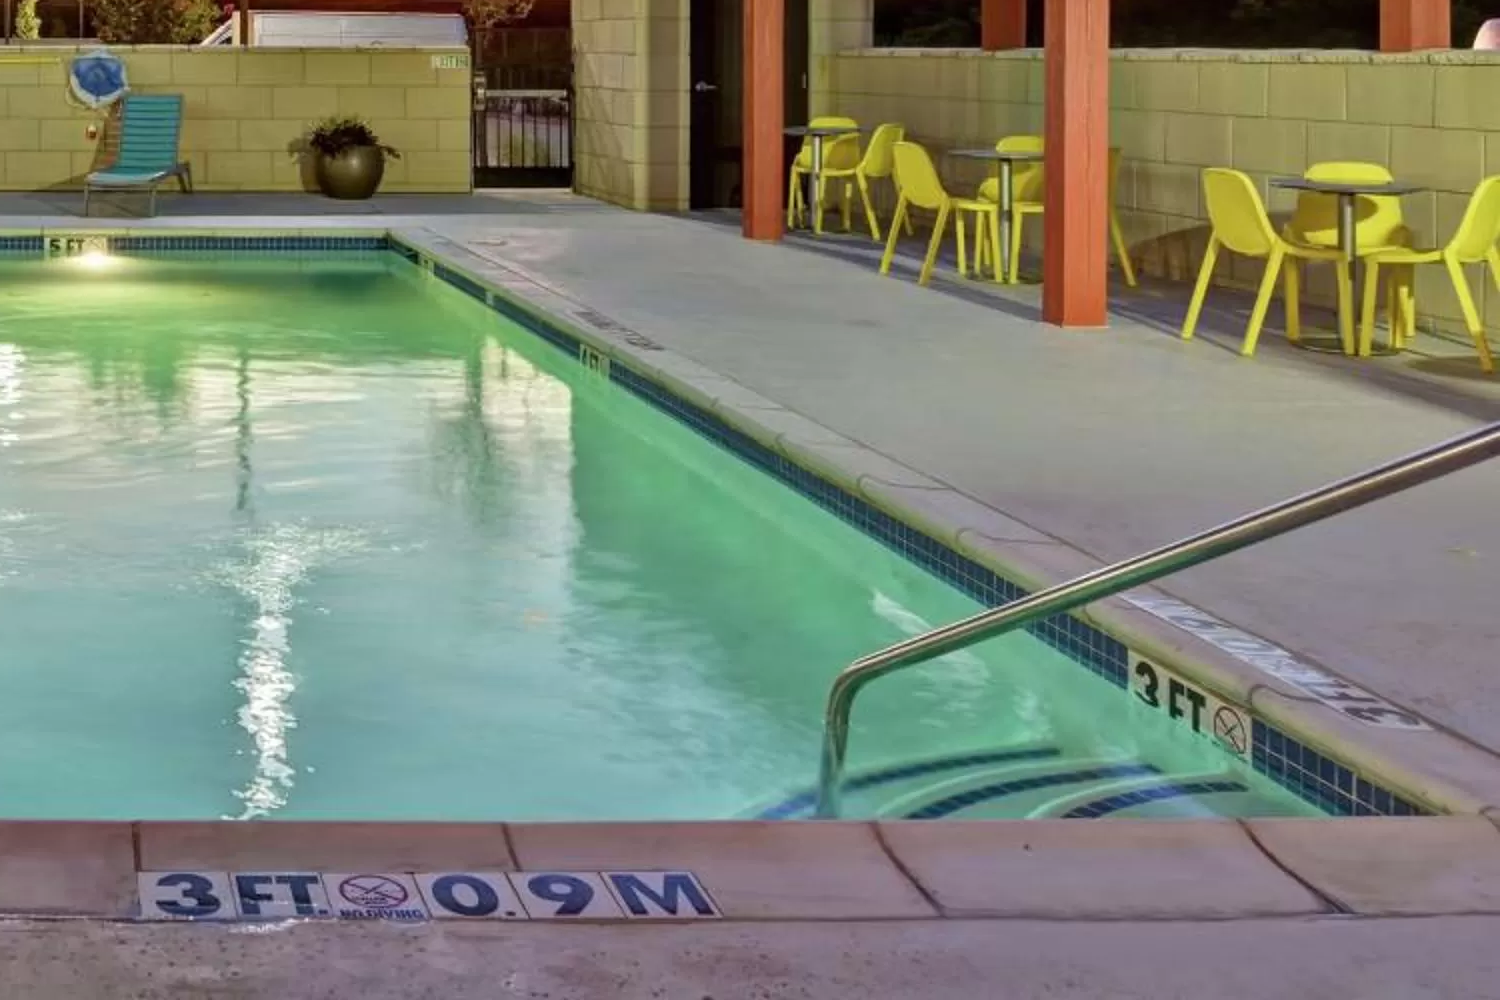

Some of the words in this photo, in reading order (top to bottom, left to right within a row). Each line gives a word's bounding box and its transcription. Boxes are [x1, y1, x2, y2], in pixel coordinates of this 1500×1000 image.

[66, 239, 85, 256] FT
[1135, 661, 1159, 708] 3
[1168, 677, 1207, 734] FT
[155, 873, 222, 917] 3
[339, 909, 366, 919] NO
[366, 909, 425, 920] DIVING
